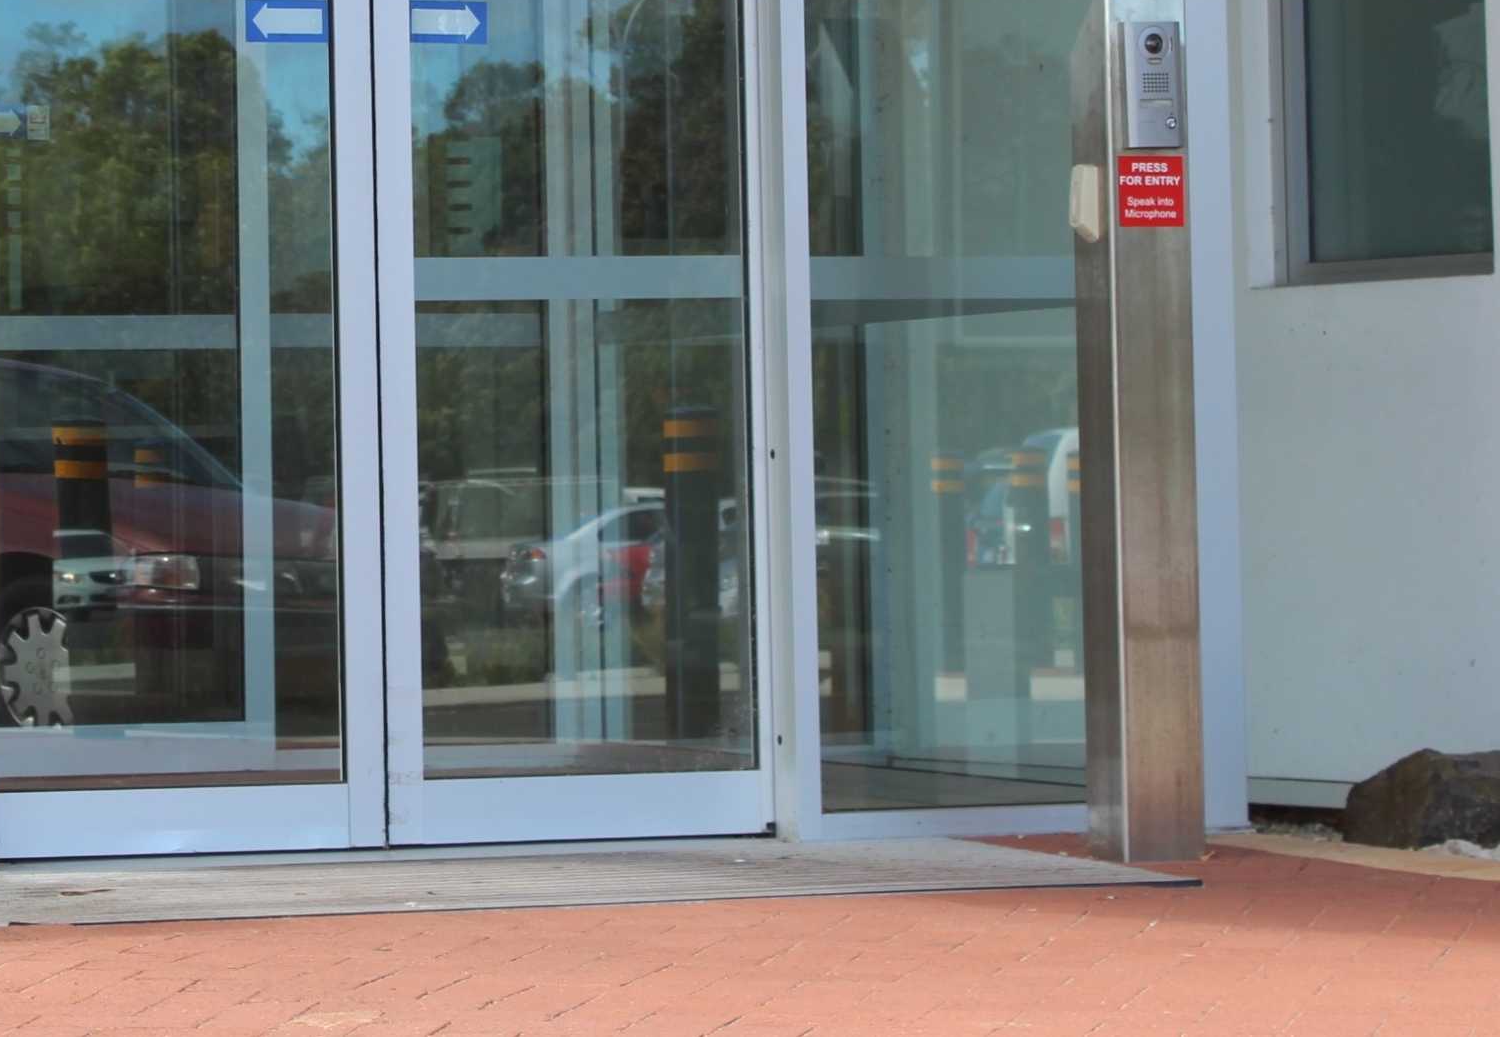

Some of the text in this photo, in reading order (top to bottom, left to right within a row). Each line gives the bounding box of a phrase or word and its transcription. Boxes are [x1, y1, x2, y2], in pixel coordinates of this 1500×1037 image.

[1131, 162, 1169, 173] PRESS
[1119, 175, 1181, 186] FOR ENTRY
[1126, 196, 1175, 208] Speak into
[1124, 208, 1177, 220] Microphone
